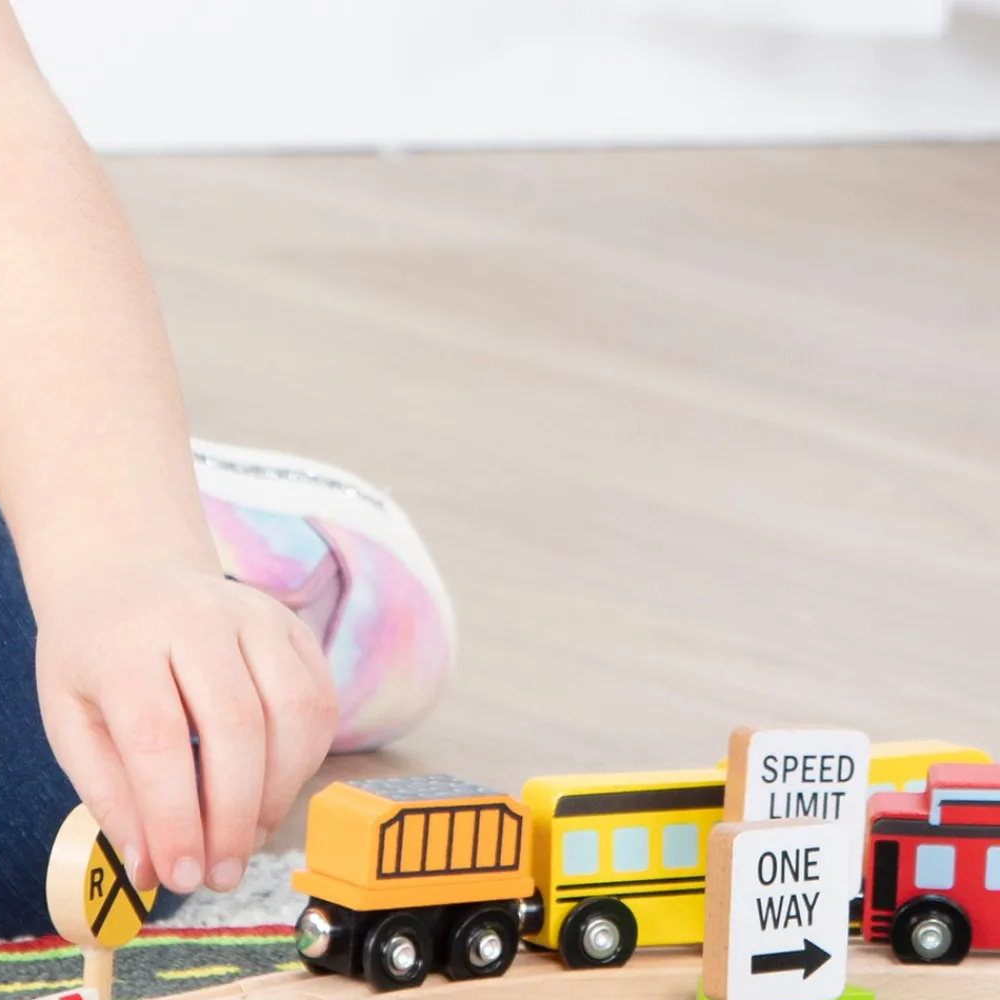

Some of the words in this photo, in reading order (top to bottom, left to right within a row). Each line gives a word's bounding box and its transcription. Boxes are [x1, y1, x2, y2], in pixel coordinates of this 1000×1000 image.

[761, 755, 855, 784] SPEED
[769, 791, 846, 820] LIMIT
[757, 846, 820, 886] ONE
[89, 867, 105, 901] R
[756, 891, 820, 931] WAY
